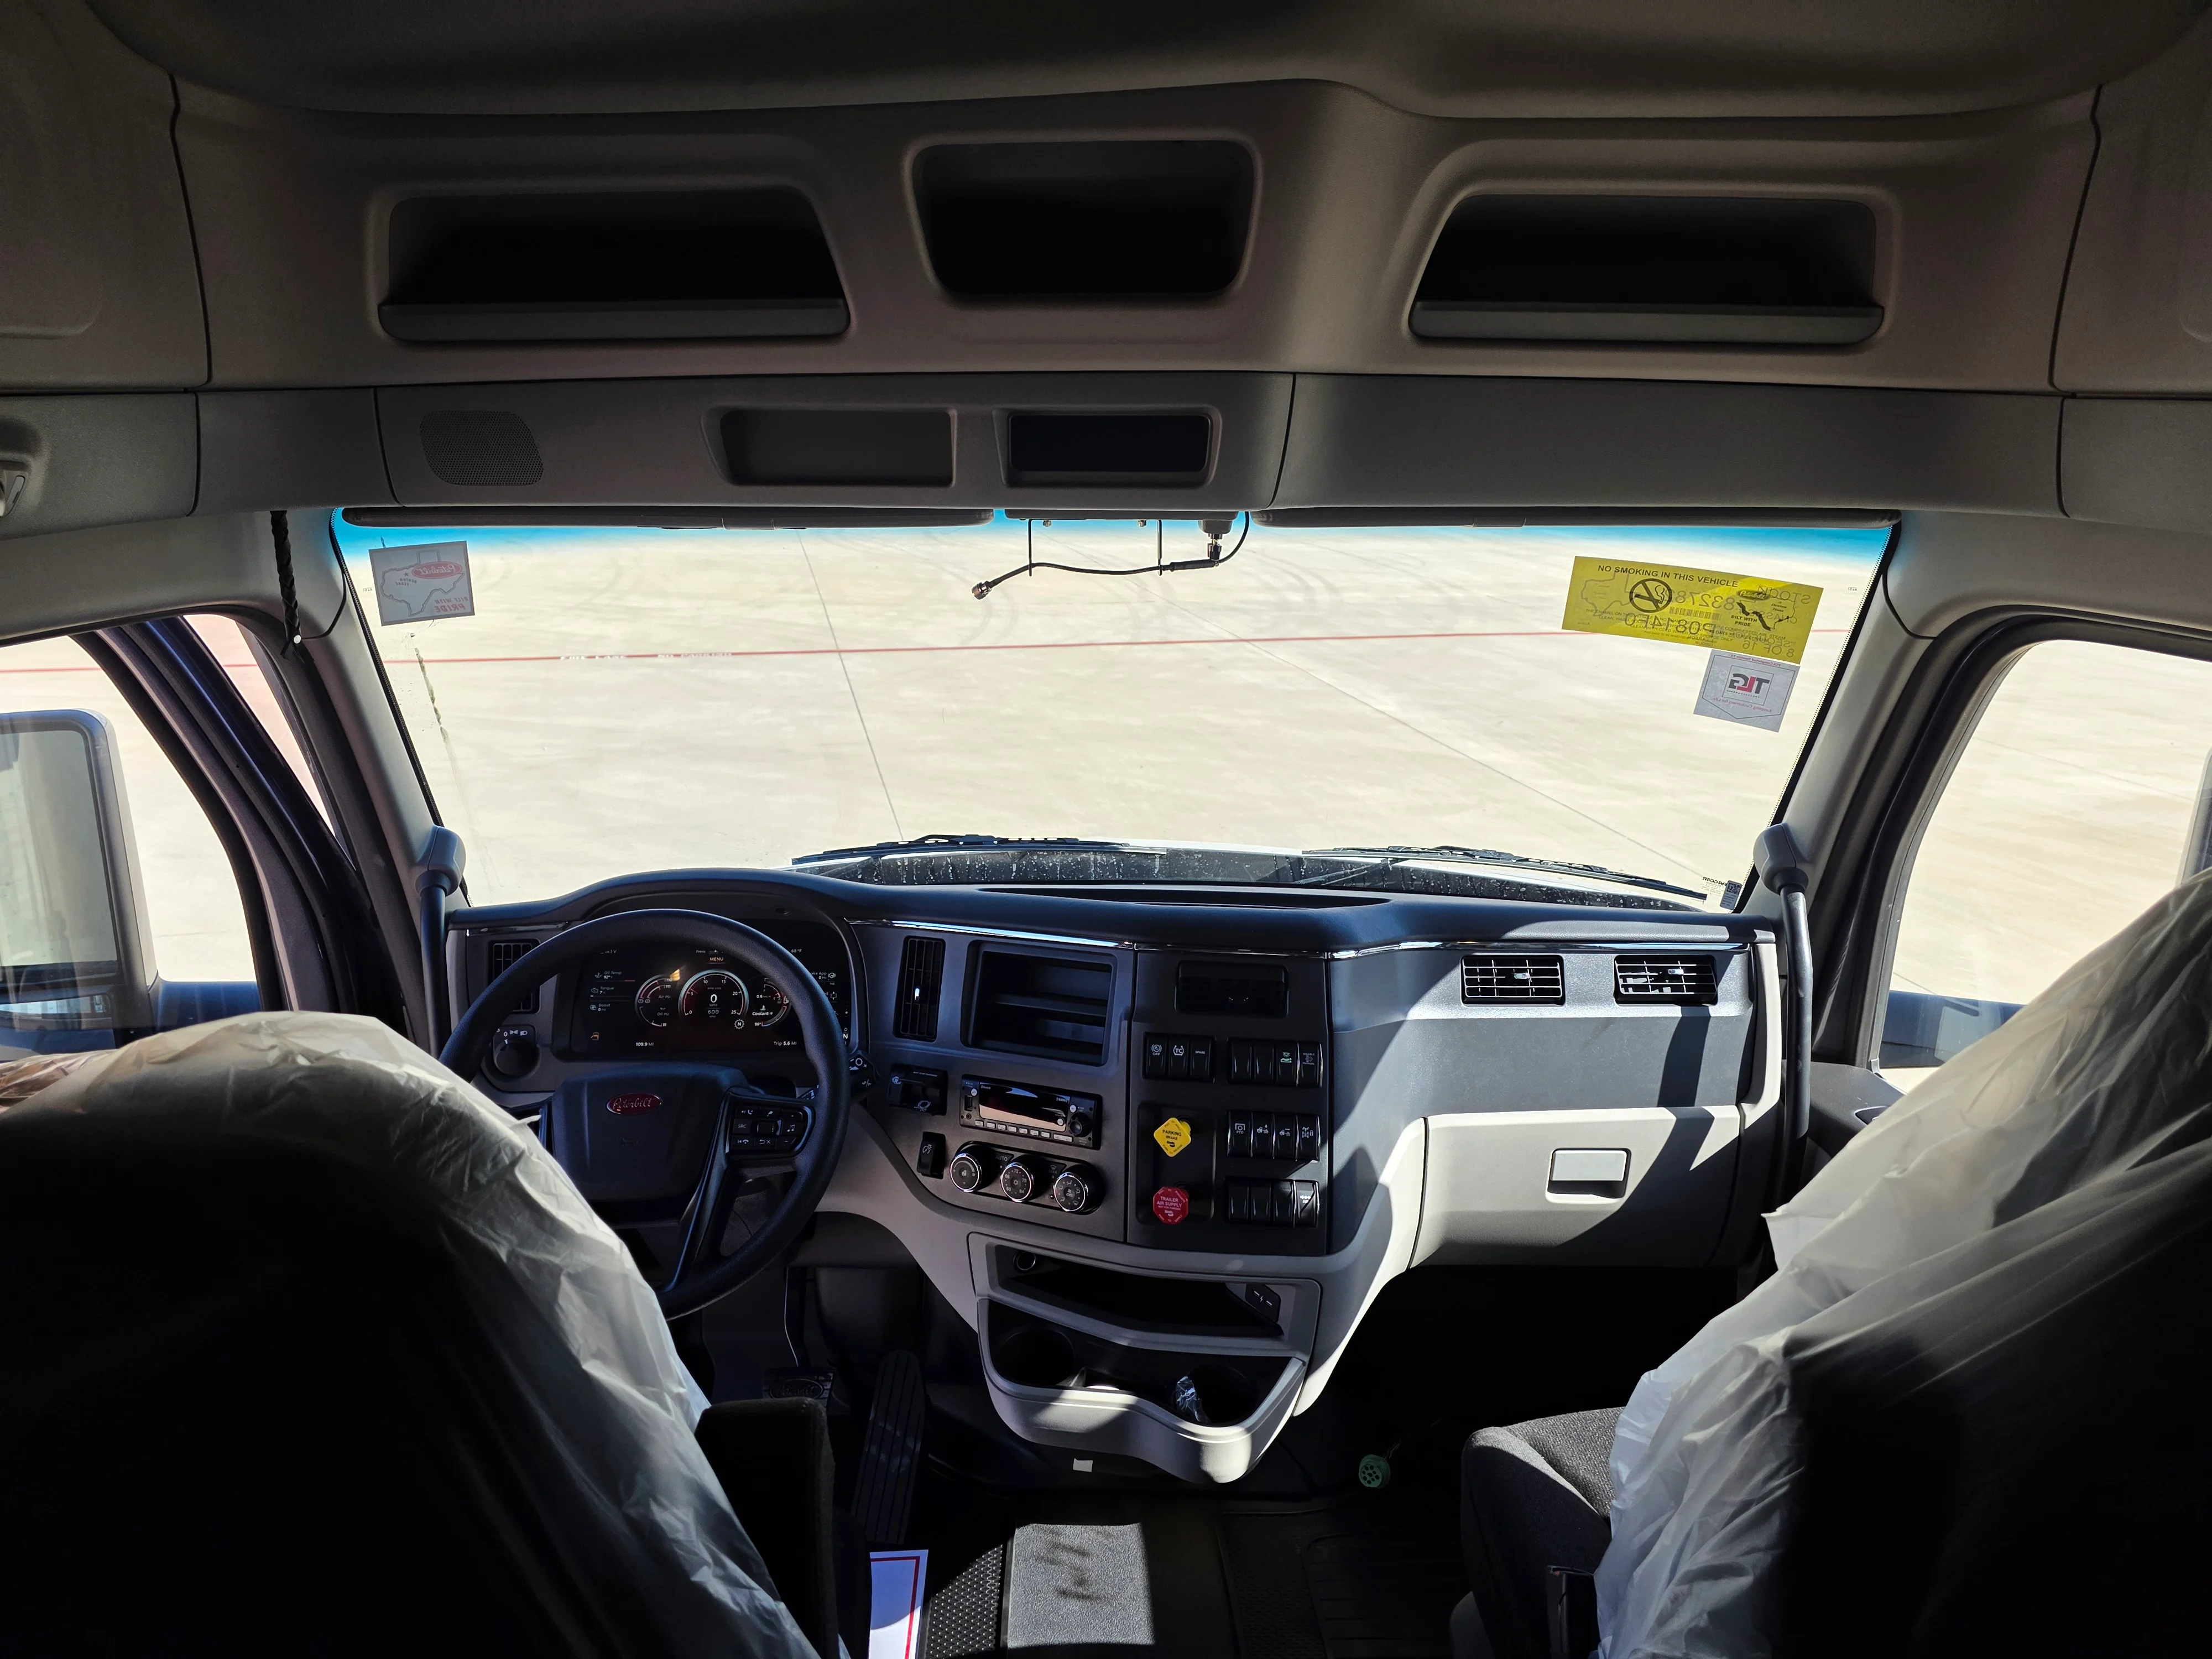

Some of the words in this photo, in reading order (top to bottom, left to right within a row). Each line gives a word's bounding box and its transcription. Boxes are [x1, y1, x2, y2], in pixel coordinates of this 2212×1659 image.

[1614, 567, 1658, 577] SMOKING
[1673, 573, 1694, 581] THIS
[1697, 576, 1739, 588] VEHICLE
[710, 994, 717, 1003] 0
[612, 1097, 656, 1109] Peterbilt
